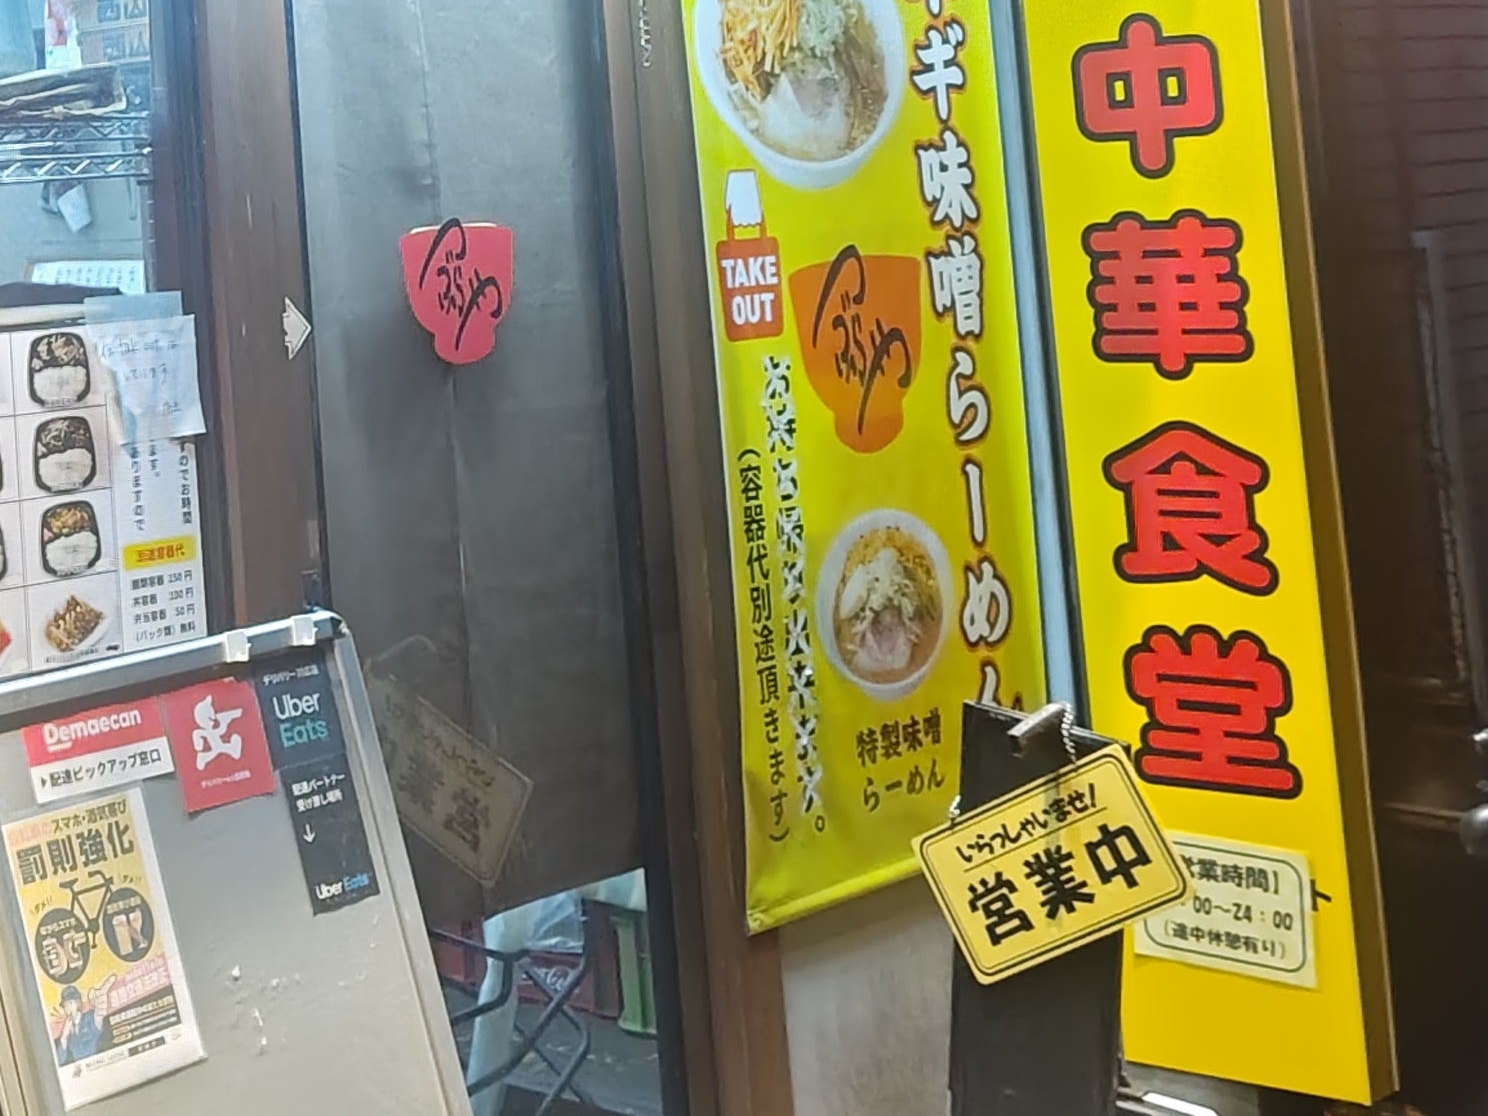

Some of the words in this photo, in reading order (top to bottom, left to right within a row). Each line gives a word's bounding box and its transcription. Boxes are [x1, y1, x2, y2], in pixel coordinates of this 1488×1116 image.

[720, 254, 779, 289] TAKE
[731, 290, 776, 326] OUT
[1070, 12, 1304, 800] 中華食堂
[42, 708, 143, 746] Demaecan
[272, 691, 321, 721] Uber
[279, 718, 329, 748] Eats
[854, 707, 943, 770] 特製味噌
[48, 747, 162, 789] 配達ピックアップ窓口
[860, 756, 946, 814] らーめん
[955, 782, 1098, 864] いらっしゃいませ!
[16, 820, 135, 885] 罰則強化
[314, 880, 343, 901] Uber
[342, 872, 370, 892] Eats
[966, 821, 1154, 947] 営業中
